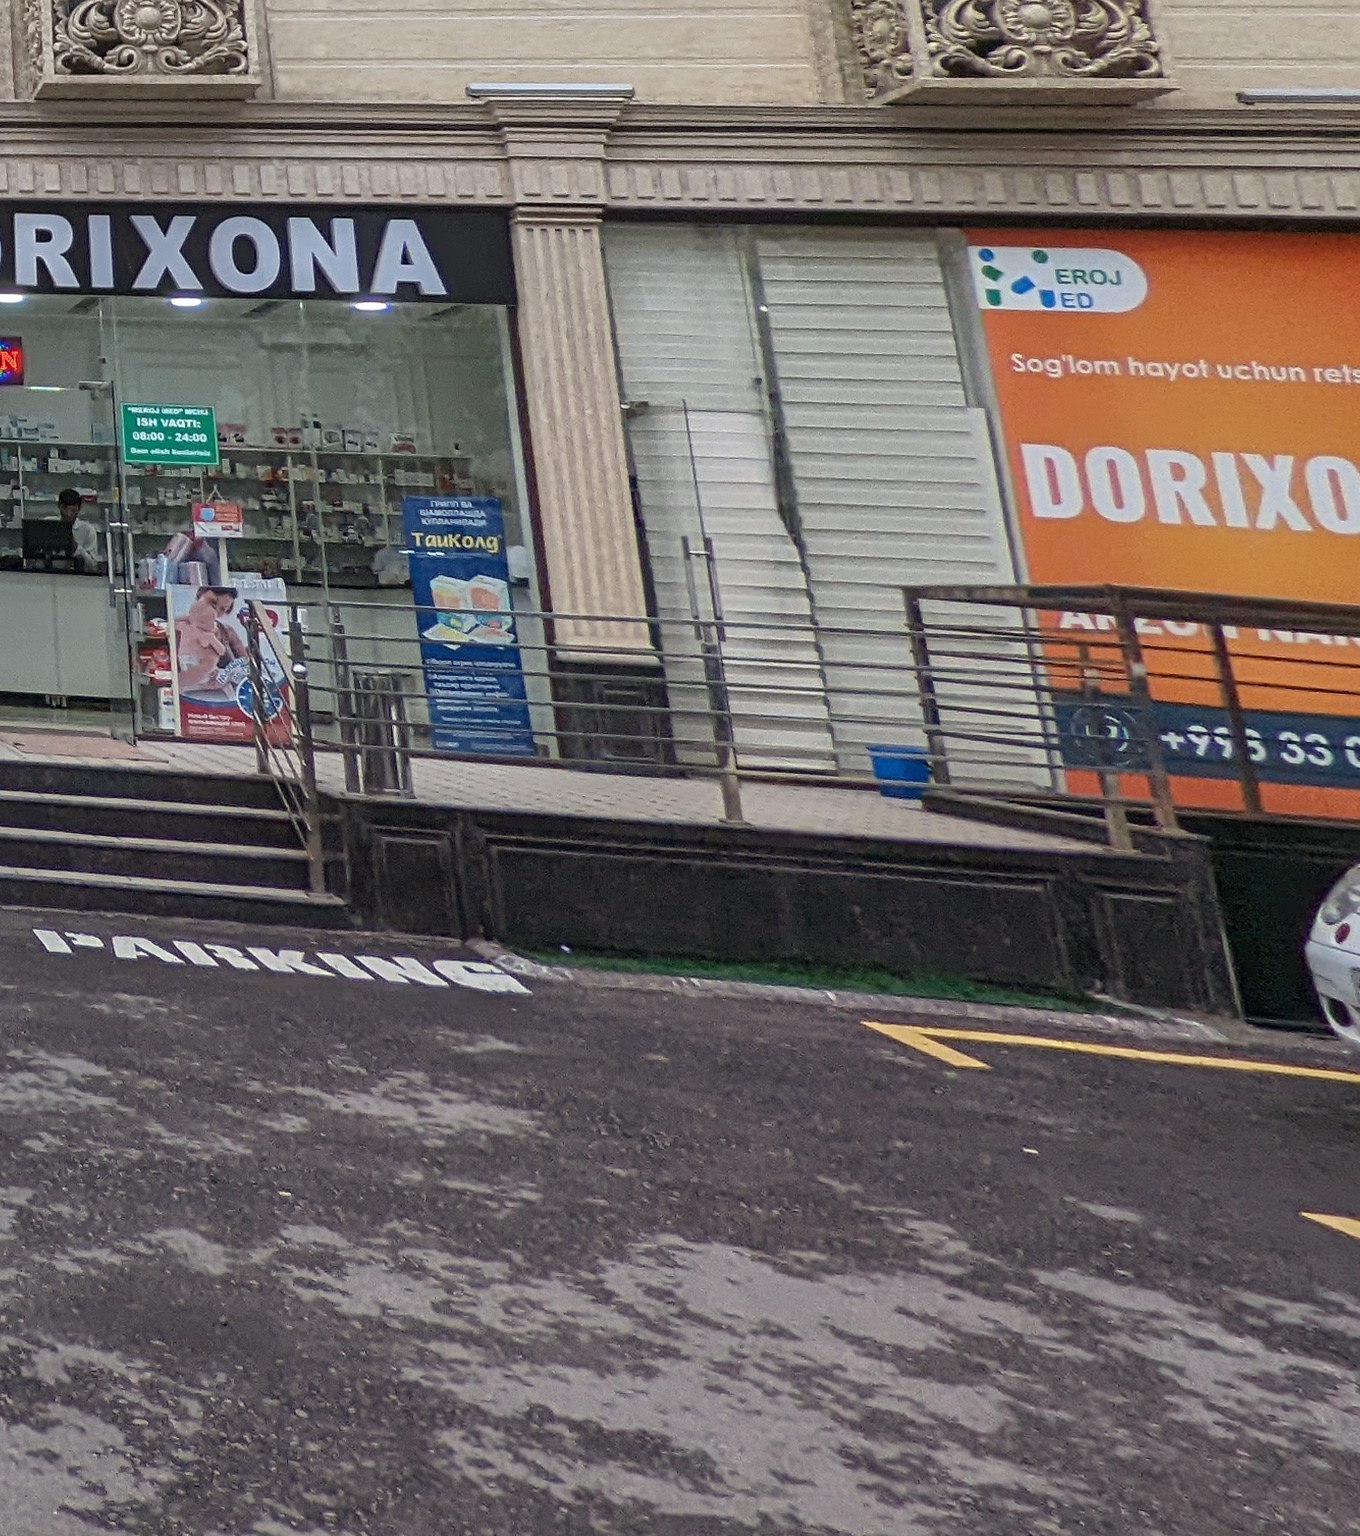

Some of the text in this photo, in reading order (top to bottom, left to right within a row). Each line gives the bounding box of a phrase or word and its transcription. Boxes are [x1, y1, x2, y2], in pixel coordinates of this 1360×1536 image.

[1128, 357, 1208, 381] hayot
[1217, 361, 1306, 383] uchun
[132, 431, 165, 441] 08:00
[174, 433, 207, 443] 24:00
[136, 417, 201, 429] ISH VAQTI:
[1021, 444, 1360, 535] DORIXO
[1279, 731, 1331, 767] 33
[32, 928, 533, 996] PARKING
